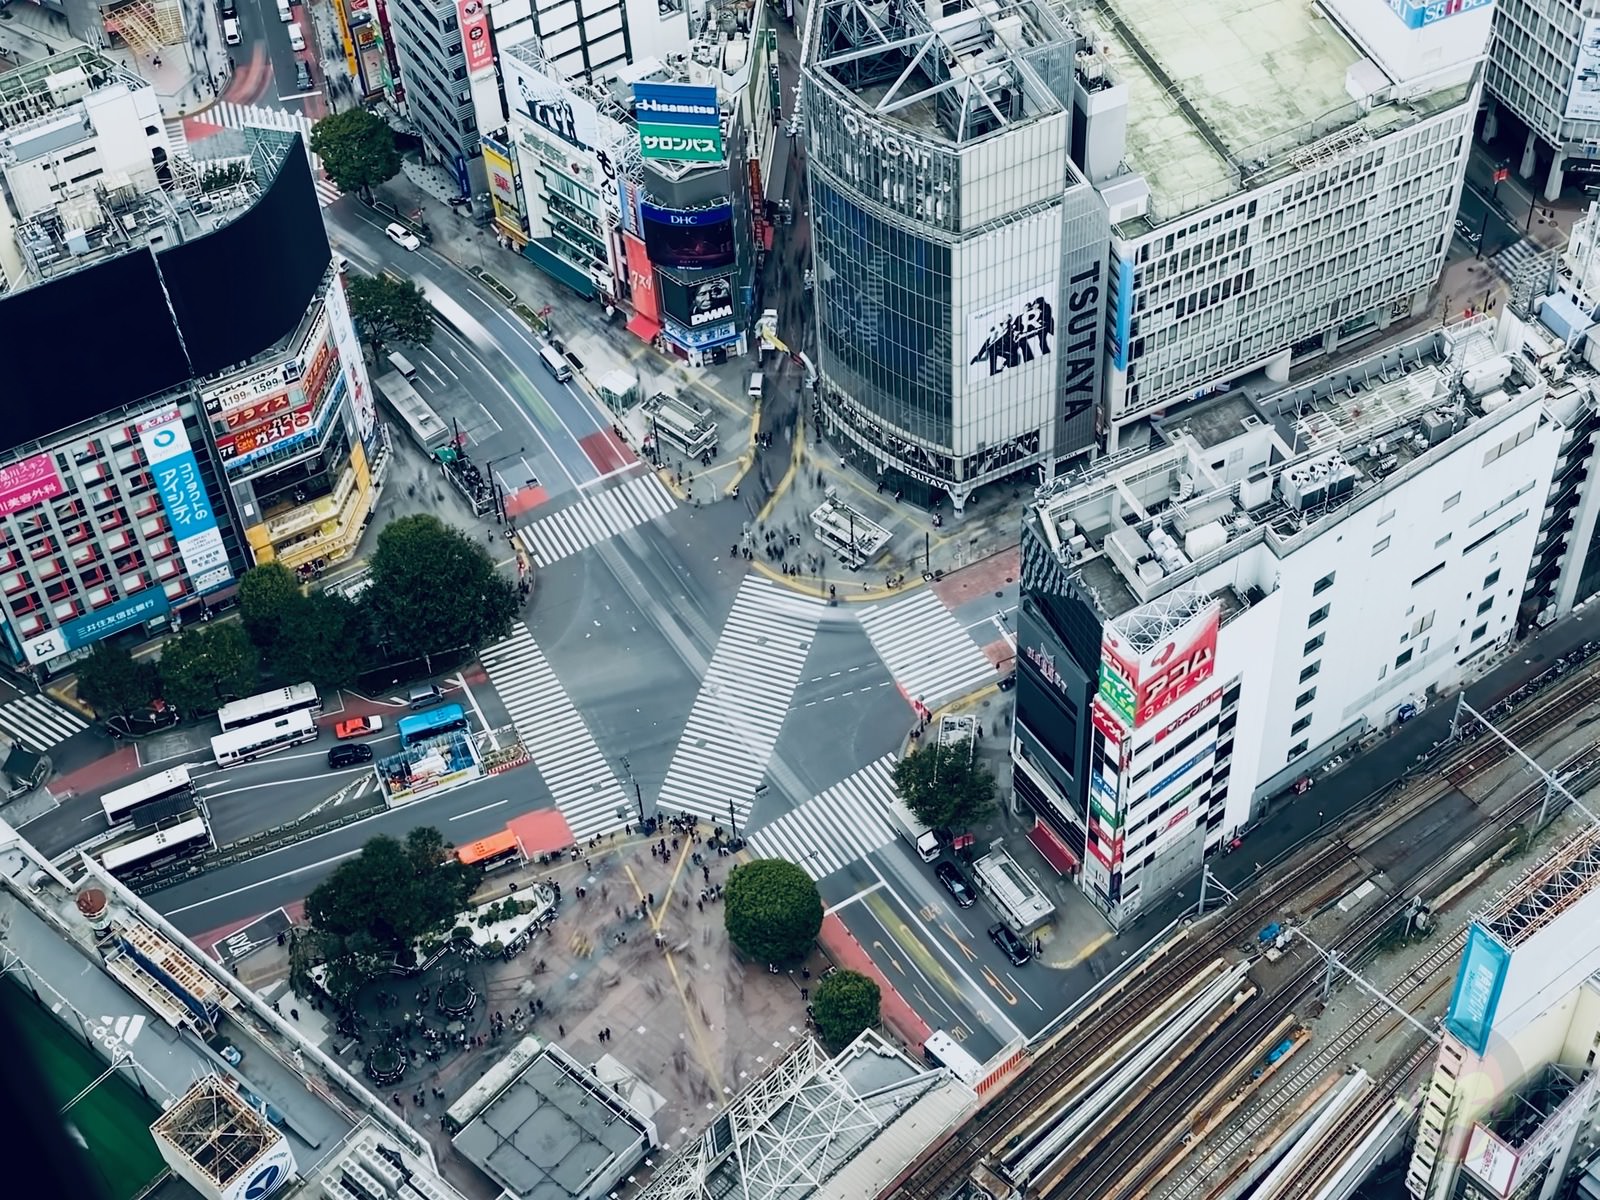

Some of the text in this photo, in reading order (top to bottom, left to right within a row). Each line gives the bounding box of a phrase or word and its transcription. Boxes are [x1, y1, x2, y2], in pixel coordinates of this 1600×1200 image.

[635, 98, 716, 116] Hisamitsu
[642, 135, 717, 153] サロンパス
[843, 113, 932, 170] QFRONT
[670, 215, 698, 225] DHC
[690, 304, 733, 326] DMM
[1064, 259, 1101, 424] TSUTAYA
[206, 400, 220, 411] 9F
[227, 396, 287, 427] プライス
[254, 425, 291, 447] ガスト
[985, 436, 1040, 462] TSUTAYA
[220, 446, 235, 458] 7F
[178, 462, 208, 520] コンタクトの
[904, 466, 952, 492] TSUTAYA
[158, 467, 193, 525] アイシティ
[76, 599, 155, 637] 三井住友信託銀行
[1145, 646, 1213, 708] アコム
